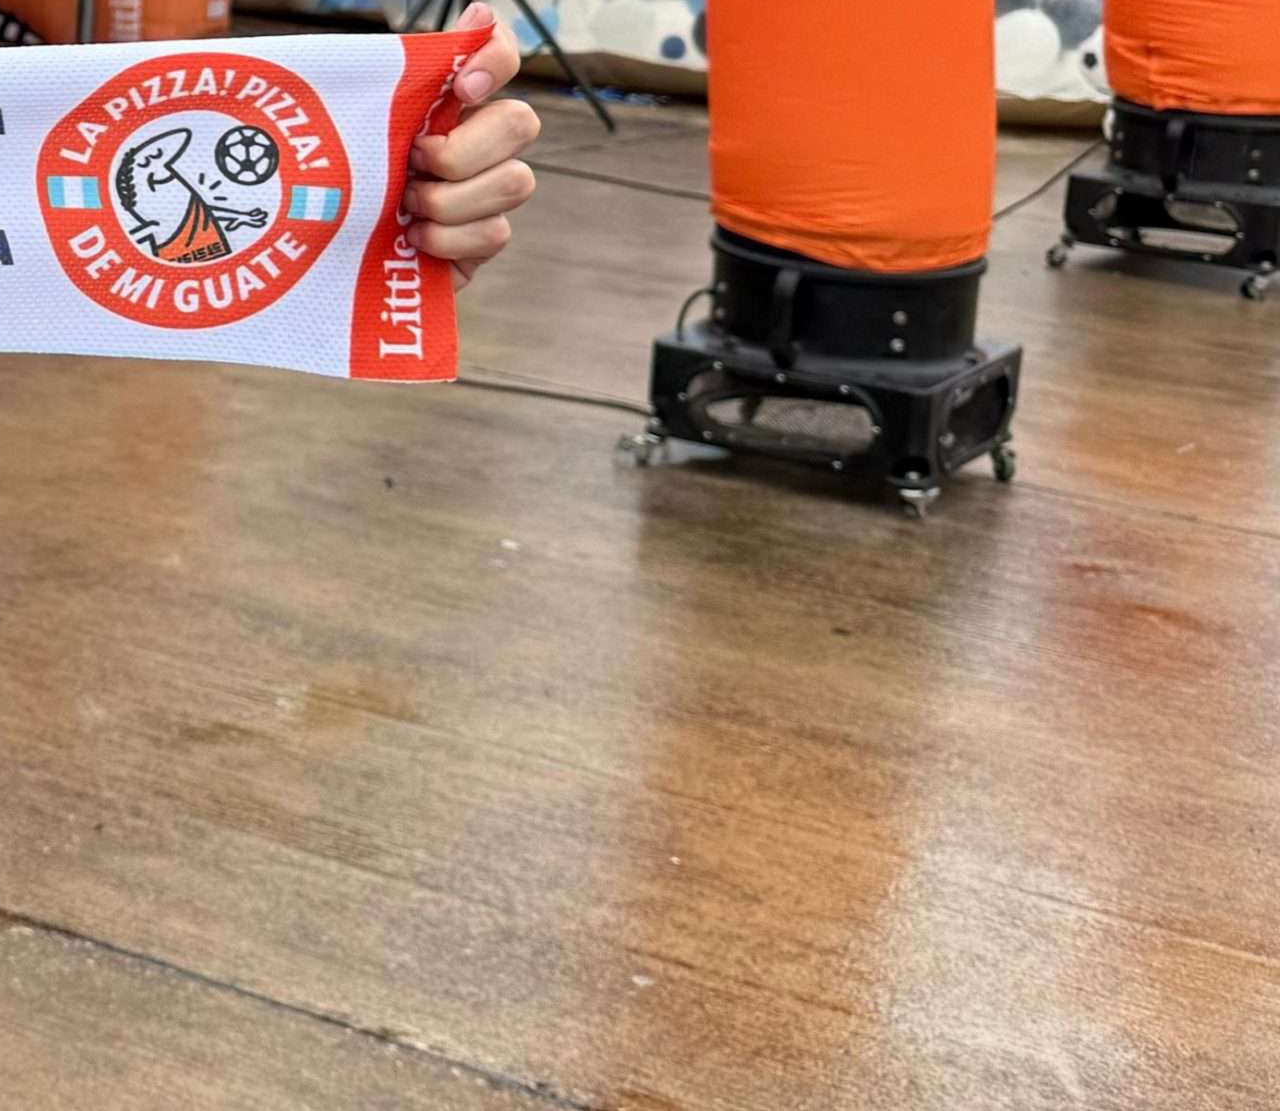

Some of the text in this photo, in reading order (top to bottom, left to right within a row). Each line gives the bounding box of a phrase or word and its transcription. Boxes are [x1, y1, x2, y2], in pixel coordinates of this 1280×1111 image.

[59, 66, 331, 172] LA PIZZA! PIZZA!
[67, 224, 309, 313] DE MI GUATE
[378, 233, 425, 360] Little
